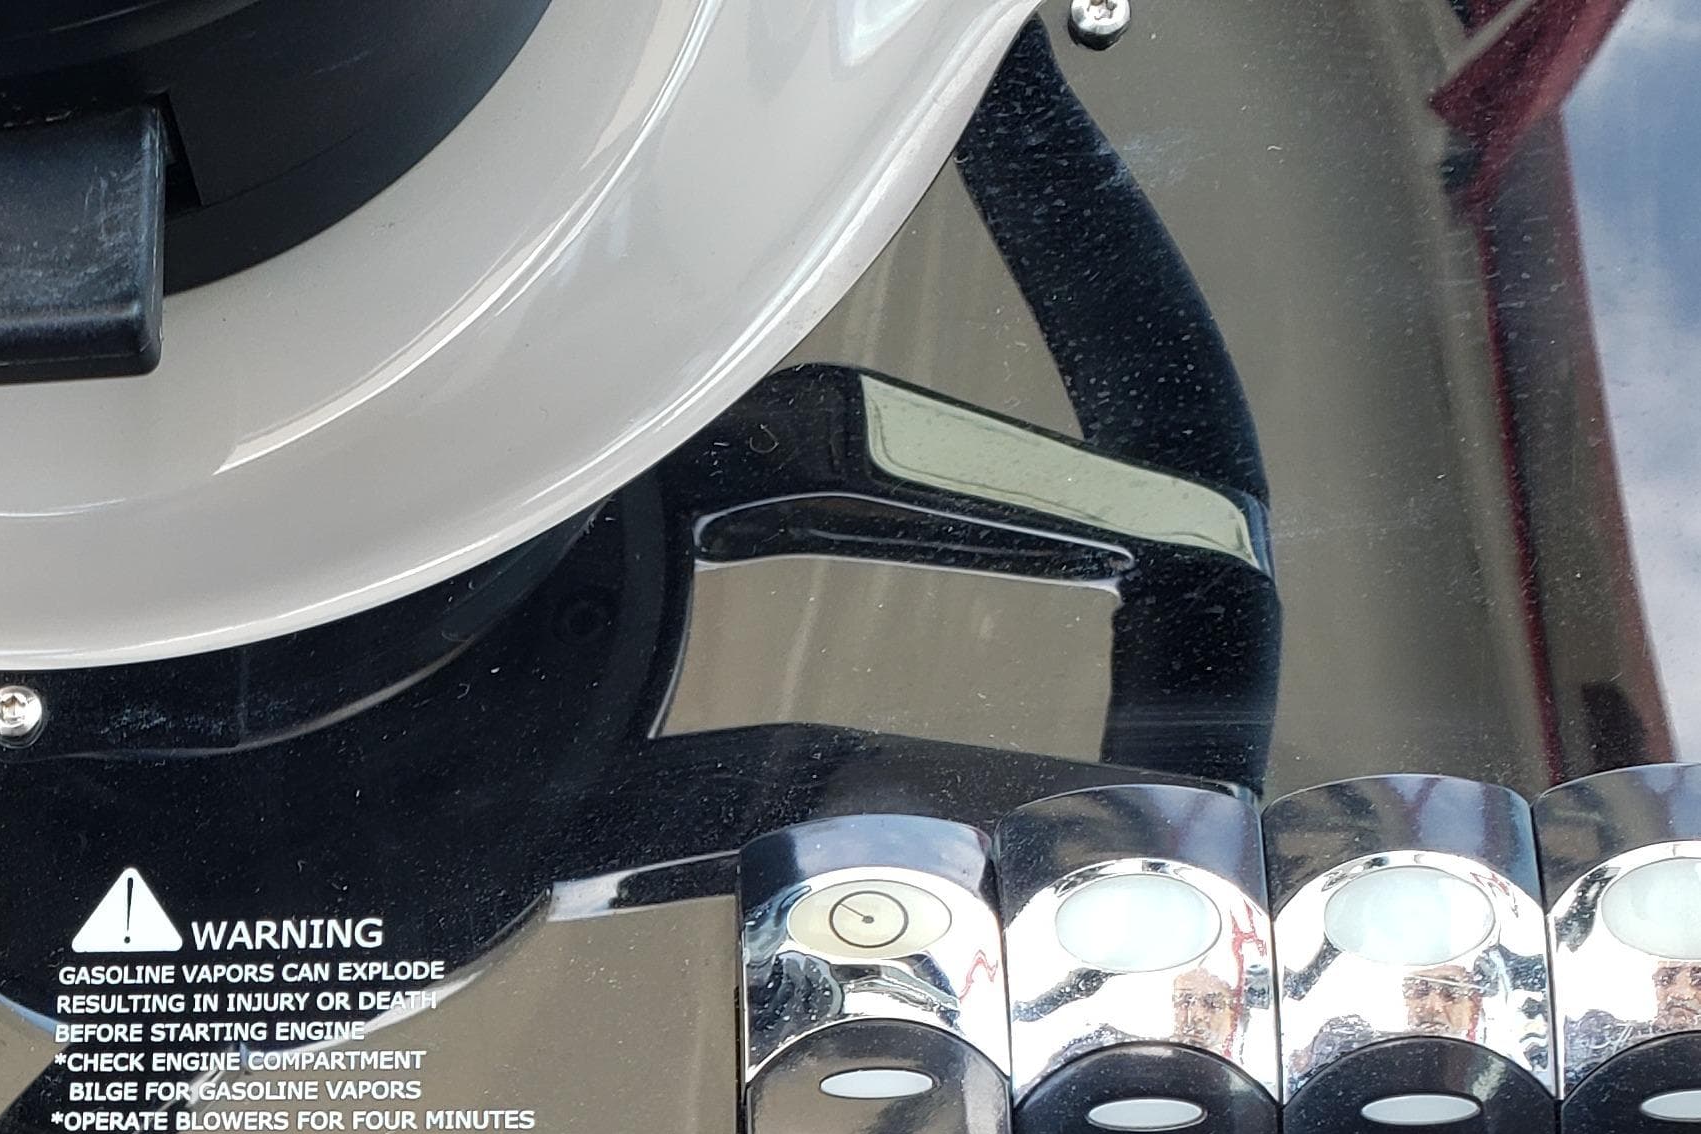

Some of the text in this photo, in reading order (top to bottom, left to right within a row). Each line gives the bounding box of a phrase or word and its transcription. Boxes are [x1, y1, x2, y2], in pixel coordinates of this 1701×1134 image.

[191, 918, 384, 951] WARNING
[58, 960, 445, 986] GASOLINE VAPORS CAN EXPLODE
[56, 991, 437, 1014] RESULTING IN INJURY OR DEATH
[54, 1021, 366, 1043] BEFORE STARTING ENGINE
[151, 1051, 241, 1071] ENGINE
[247, 1050, 427, 1070] COMPARTMENT
[68, 1079, 422, 1102] BILGE FOR GASOLINE VAPORS
[175, 1111, 289, 1131] BLOWERS
[297, 1111, 345, 1130] FOR
[352, 1110, 418, 1130] FOUR
[425, 1110, 535, 1130] MINUTES
